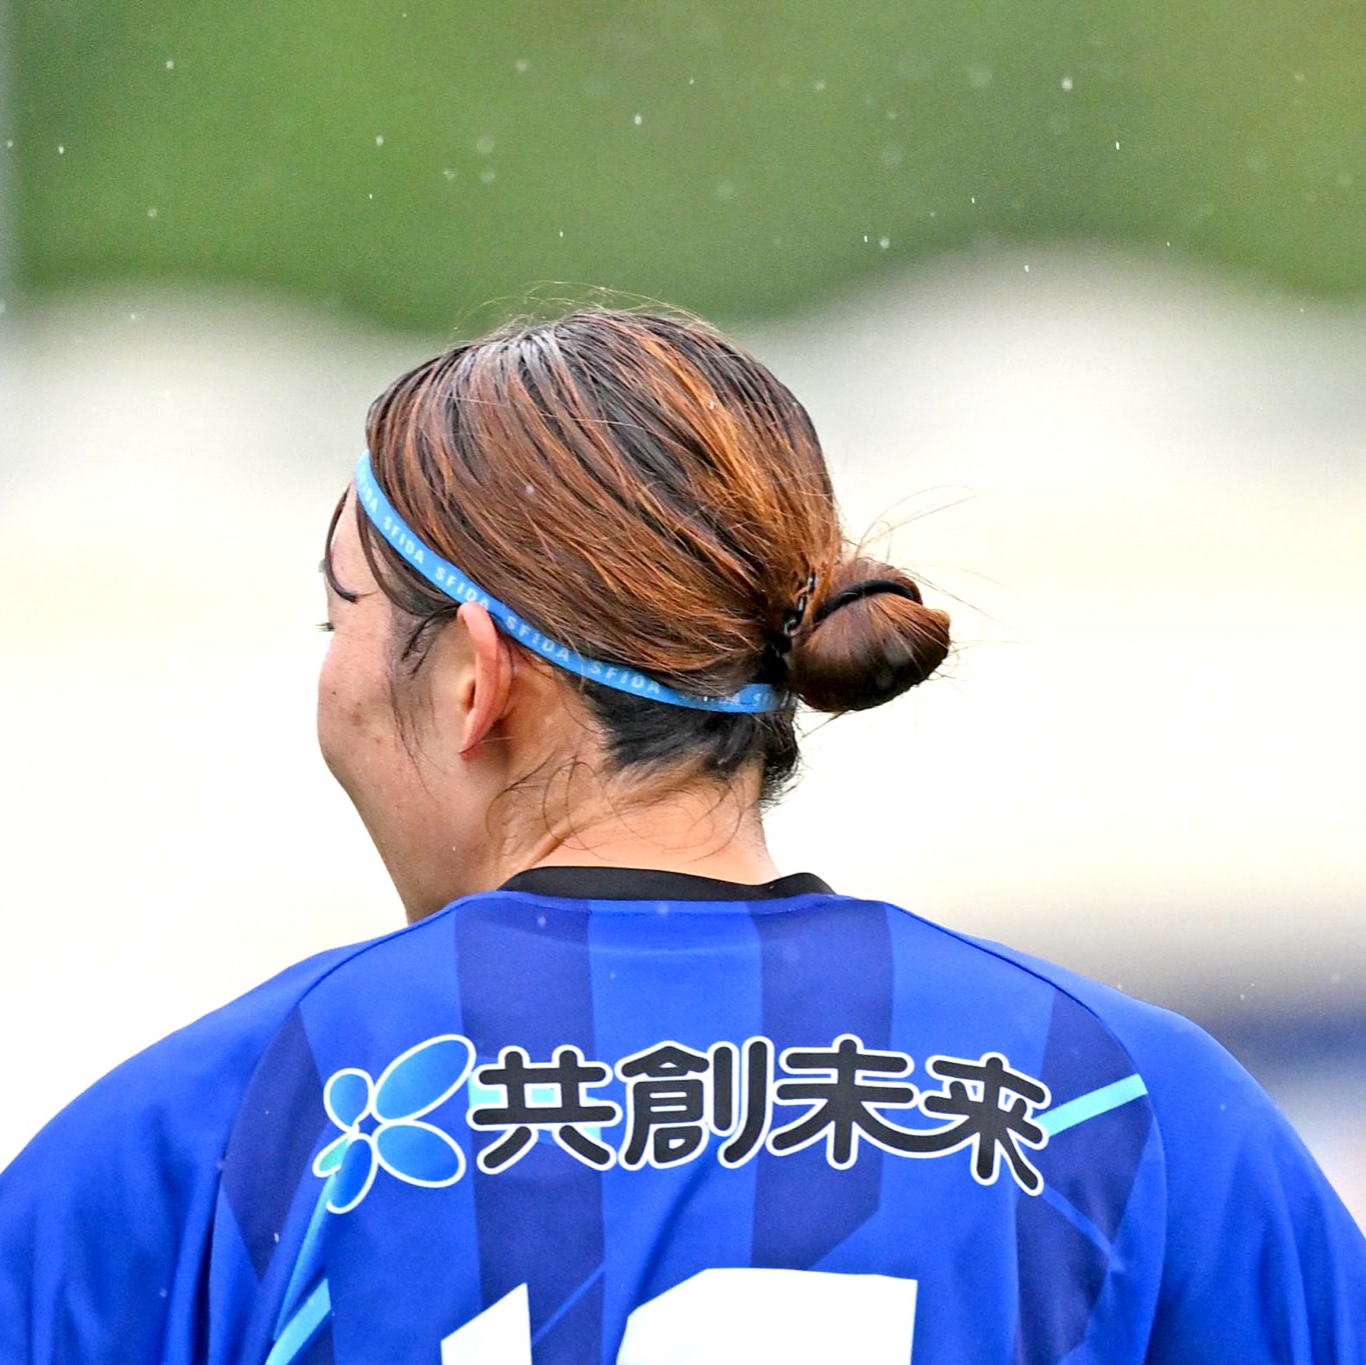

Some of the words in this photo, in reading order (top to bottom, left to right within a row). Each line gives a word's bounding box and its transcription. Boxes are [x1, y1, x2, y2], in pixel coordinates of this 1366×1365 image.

[383, 516, 426, 564] SFIDA
[435, 567, 490, 611] SFIDA
[505, 615, 570, 662] SFIDA
[590, 661, 660, 694] SFIDA
[471, 1034, 1052, 1195] 共創未来
